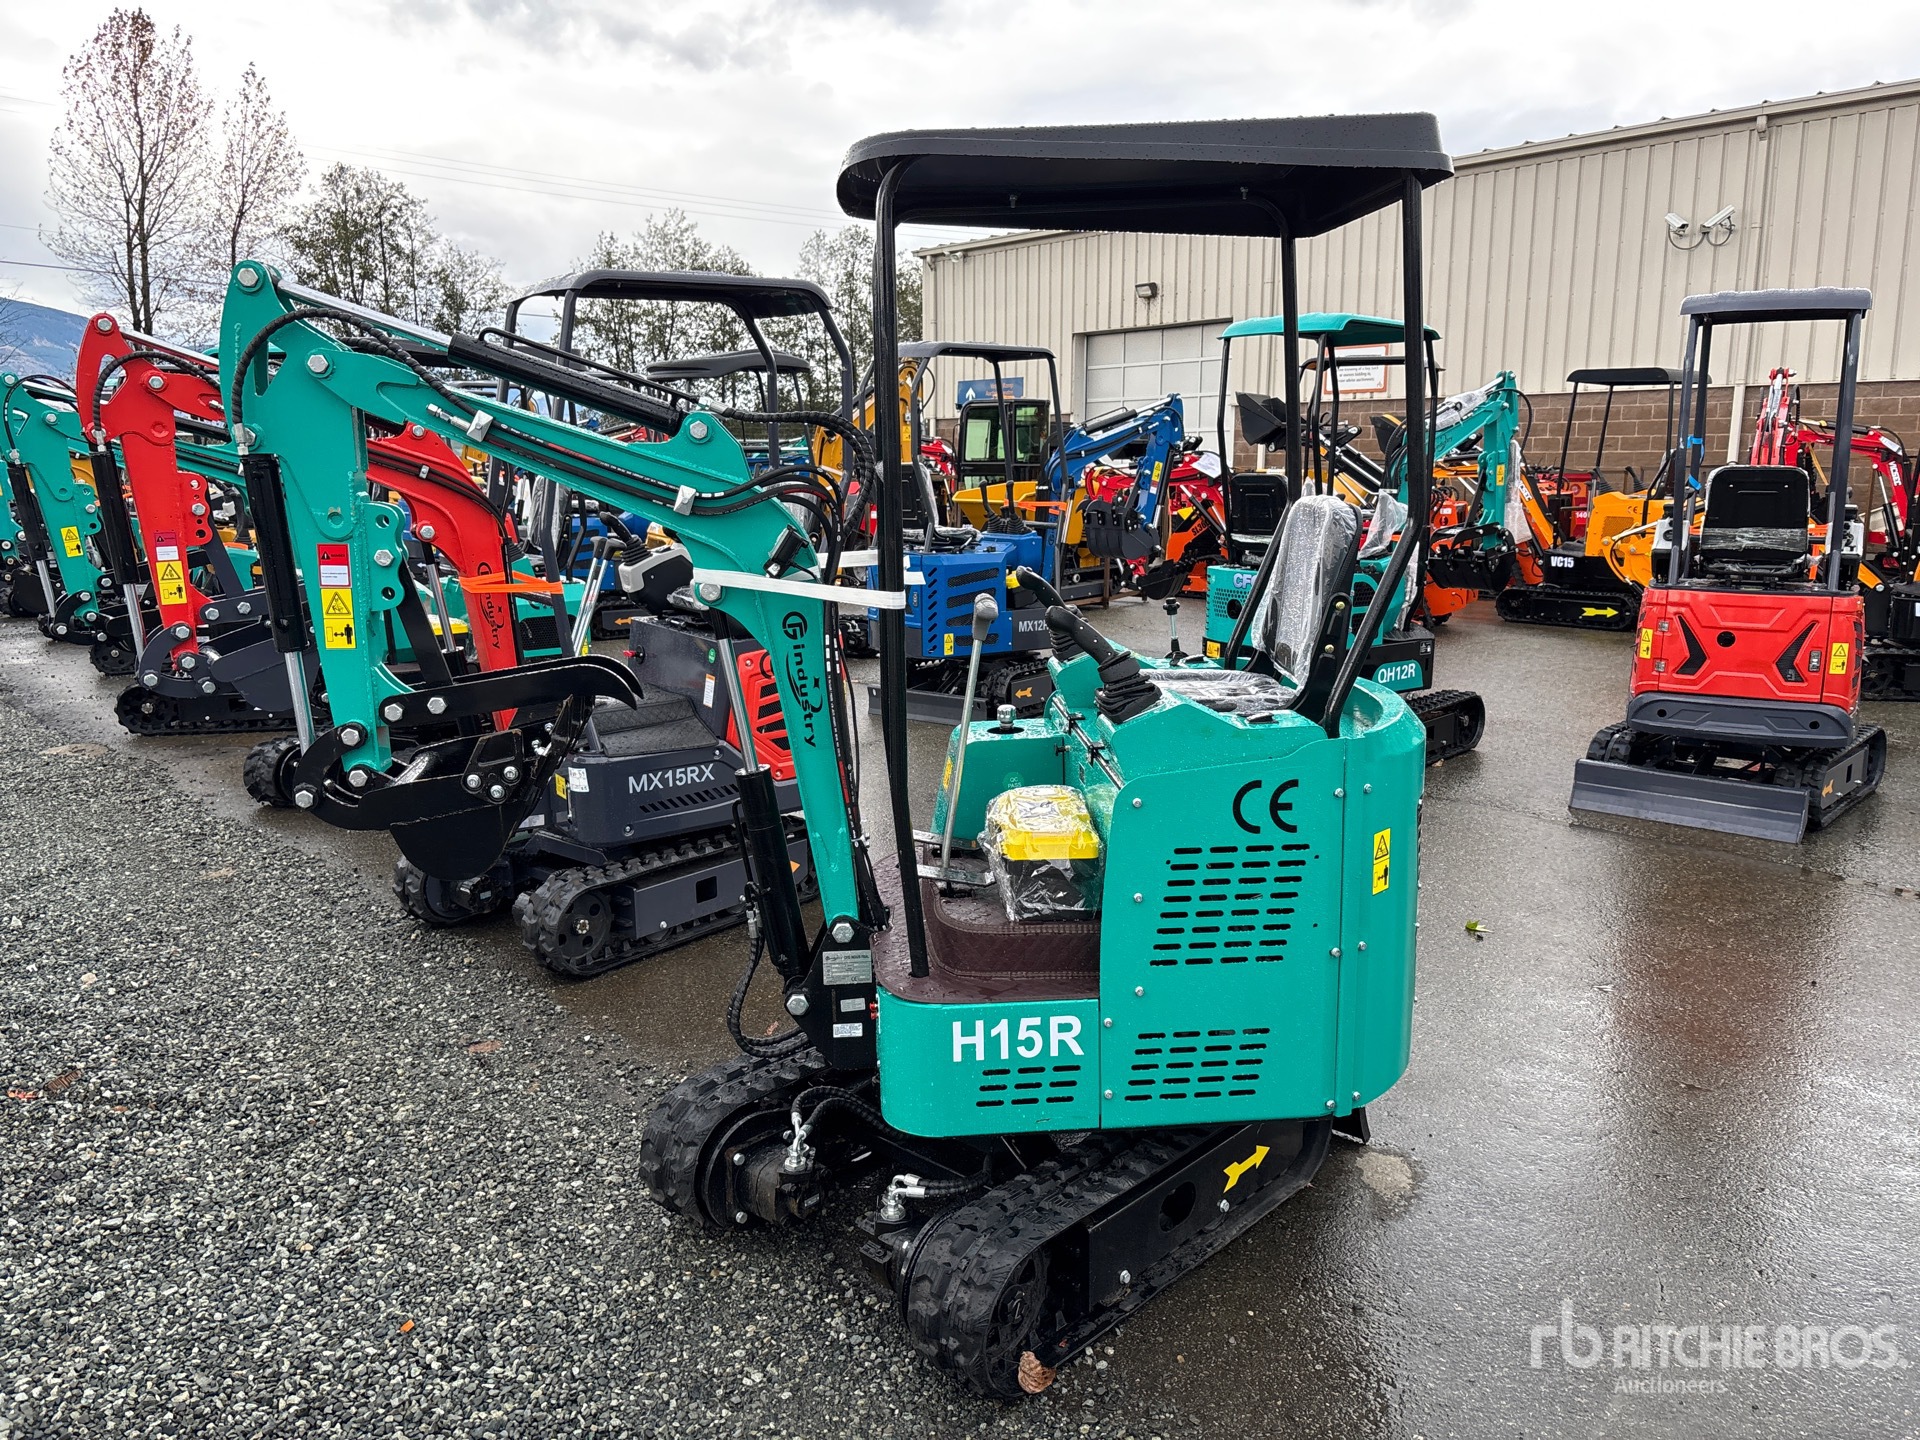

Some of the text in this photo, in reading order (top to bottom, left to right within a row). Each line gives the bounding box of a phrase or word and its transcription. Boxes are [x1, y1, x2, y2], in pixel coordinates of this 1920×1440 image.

[1550, 555, 1575, 568] VC15
[1377, 662, 1416, 684] QH12R
[628, 762, 716, 794] MX15RX
[1232, 779, 1300, 834] CE
[951, 1015, 1086, 1063] H15R
